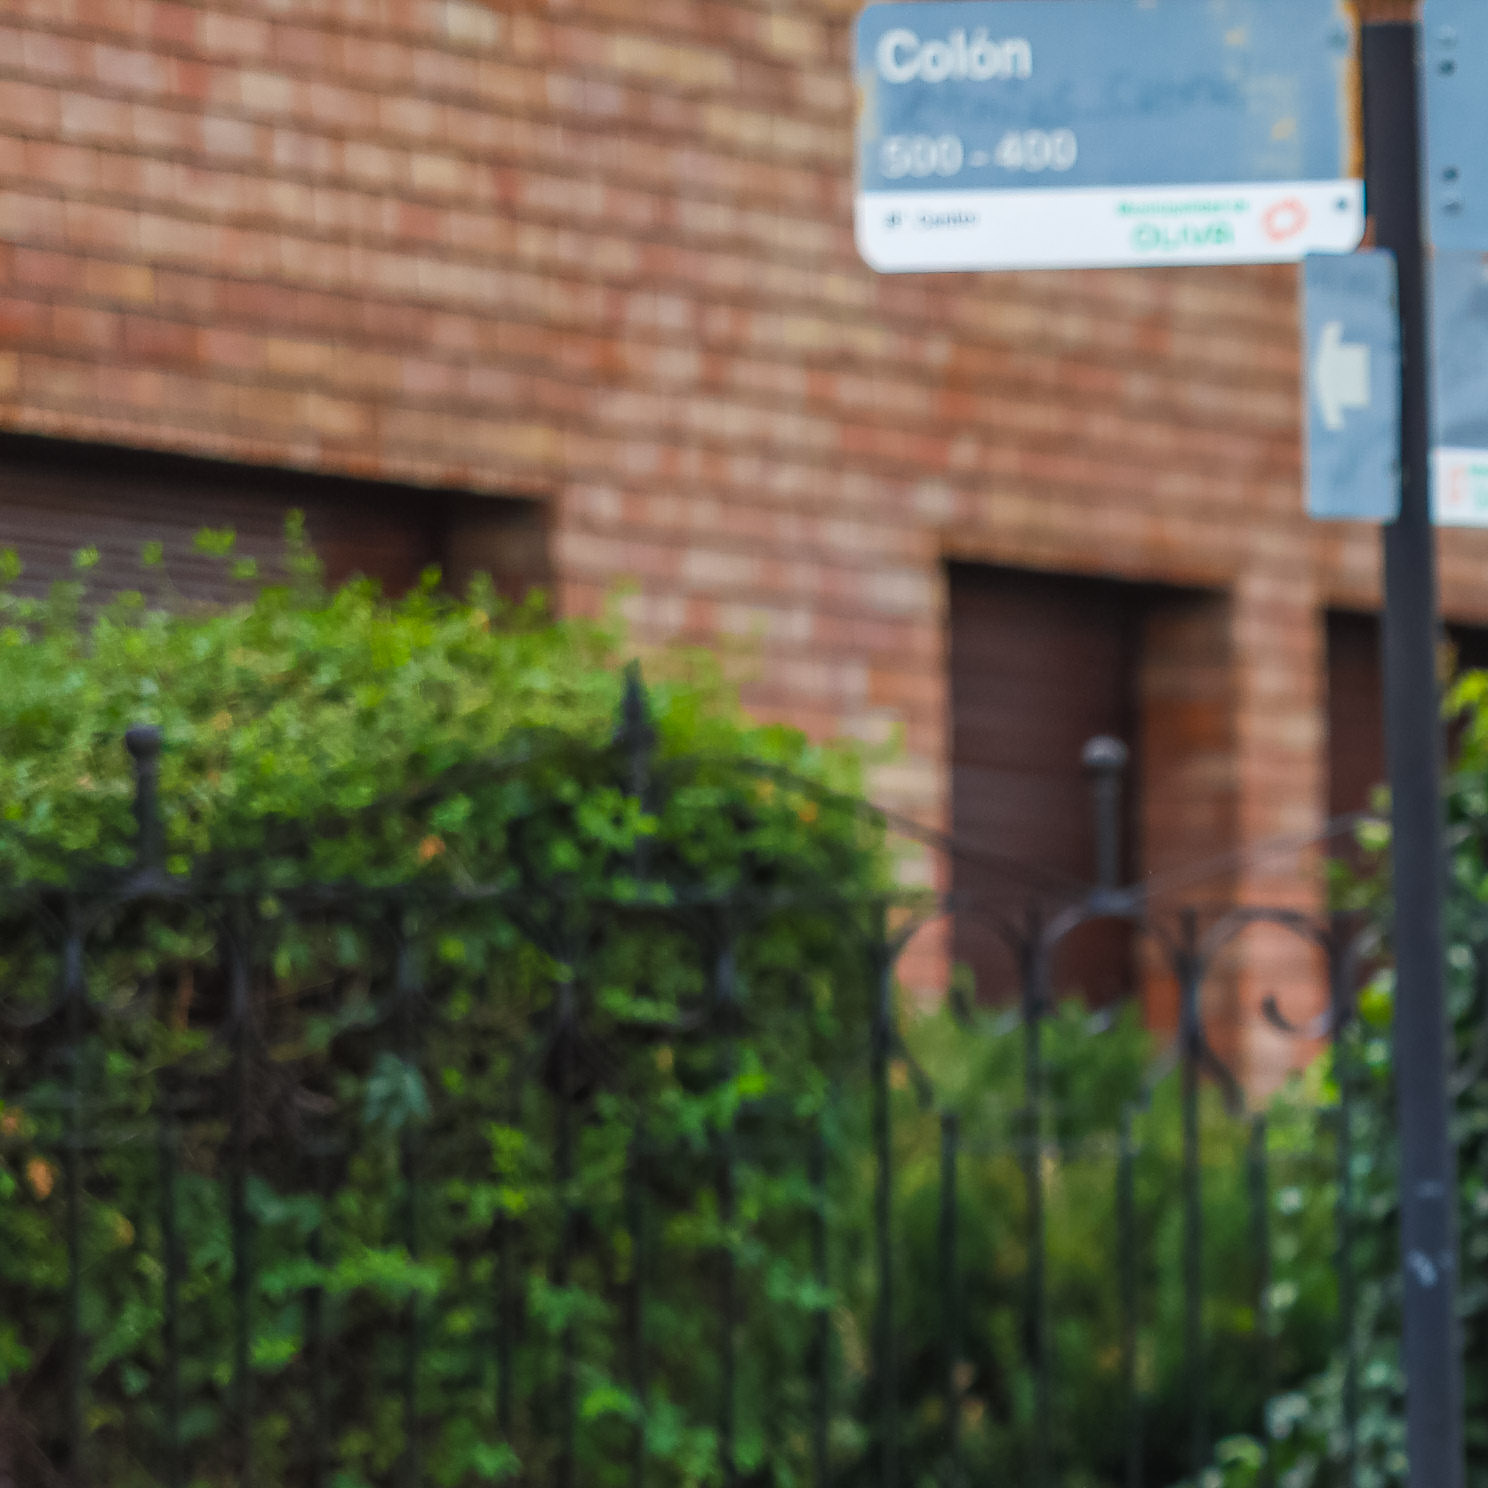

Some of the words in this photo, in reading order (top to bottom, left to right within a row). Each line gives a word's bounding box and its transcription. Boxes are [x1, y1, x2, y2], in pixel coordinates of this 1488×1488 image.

[877, 27, 1031, 84] Colón
[881, 134, 964, 179] 500
[996, 128, 1077, 173] 400
